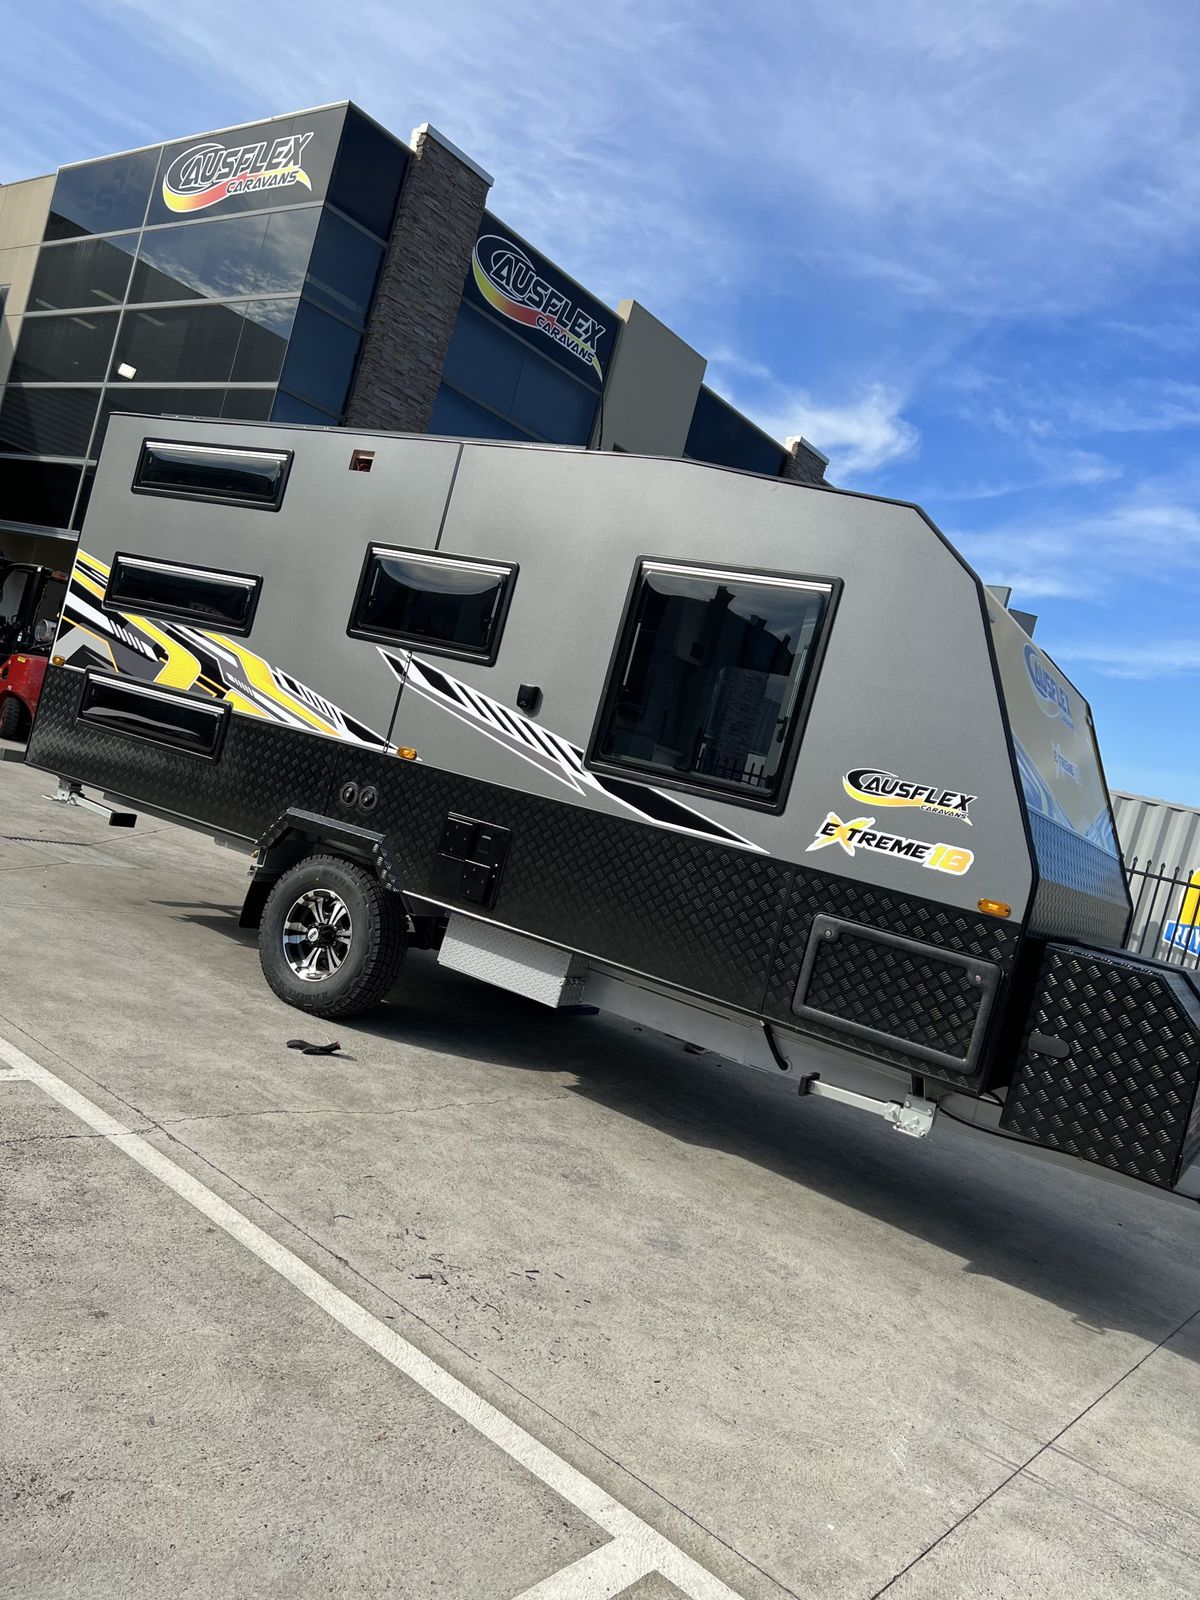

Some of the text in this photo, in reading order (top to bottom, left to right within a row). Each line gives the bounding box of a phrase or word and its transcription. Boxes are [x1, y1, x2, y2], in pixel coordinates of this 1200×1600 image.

[179, 132, 314, 188] AUSFLEX
[226, 170, 299, 194] CARAVANS
[490, 253, 606, 353] AUSFLEX
[536, 315, 594, 365] CARAVANS
[861, 775, 977, 813] AUSFLEX
[920, 805, 967, 820] CARAVANS
[806, 811, 972, 873] EXTREME 18
